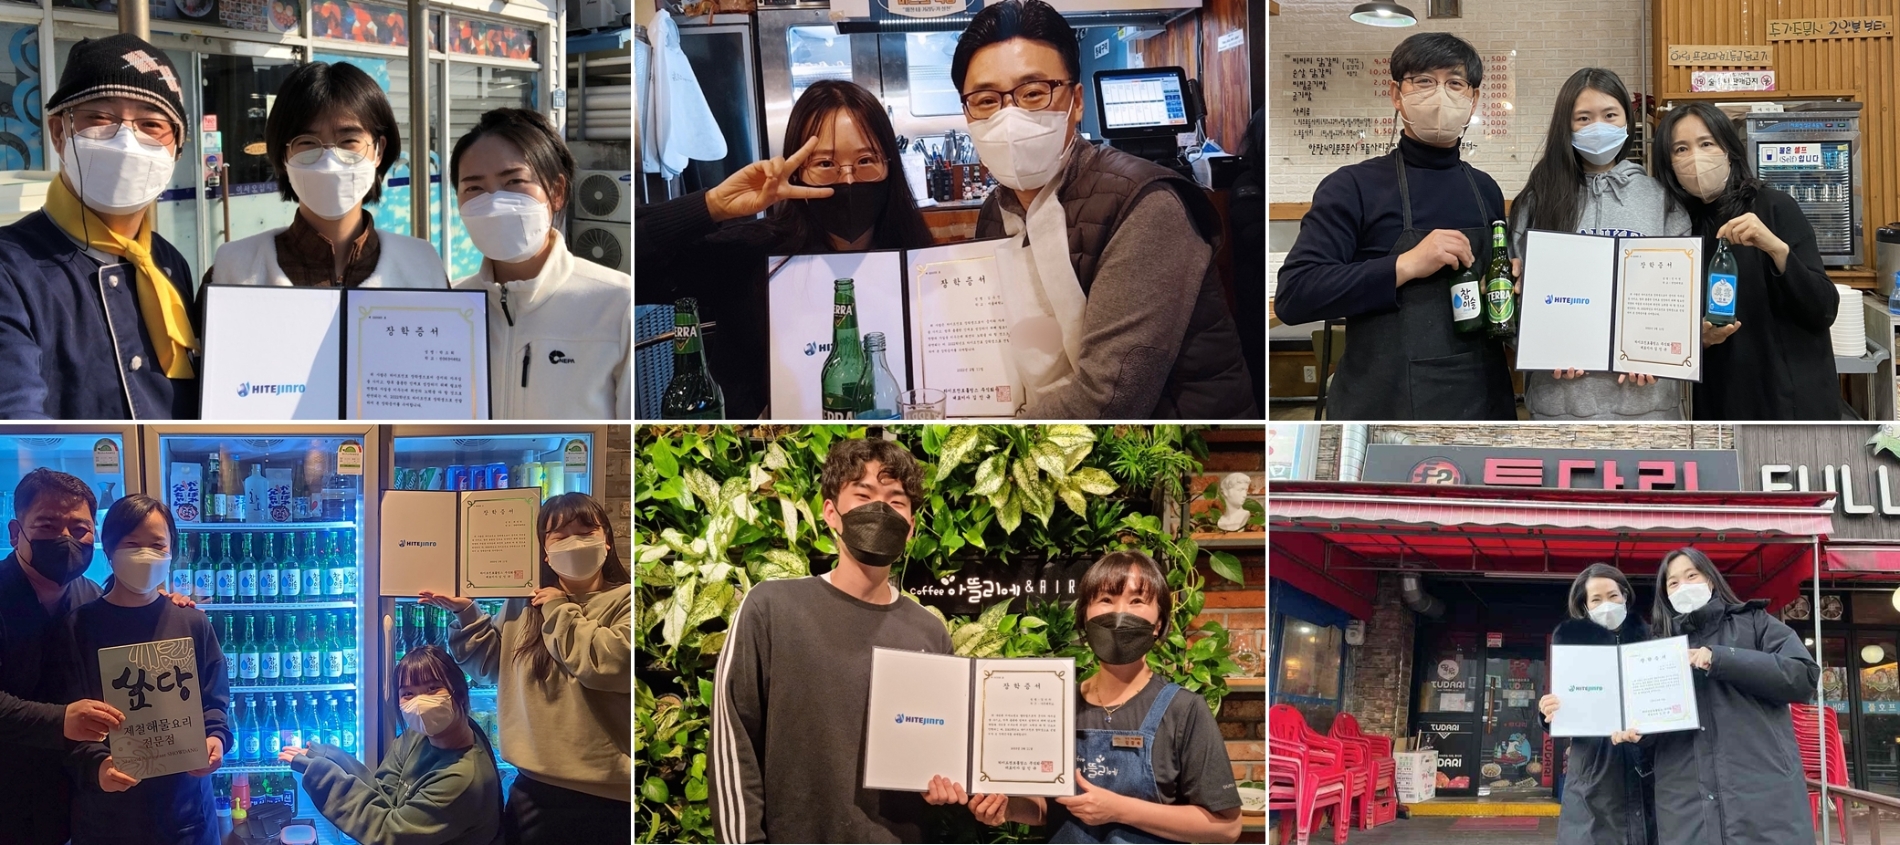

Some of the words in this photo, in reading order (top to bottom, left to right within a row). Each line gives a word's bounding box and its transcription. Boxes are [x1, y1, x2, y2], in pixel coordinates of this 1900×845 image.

[1487, 290, 1511, 302] TERRA
[832, 304, 852, 315] ERRA
[674, 326, 697, 337] ERRA
[1025, 580, 1034, 592] &
[124, 716, 192, 736] 제철해물요리
[143, 734, 175, 748] 전문점
[1437, 758, 1462, 767] DARI
